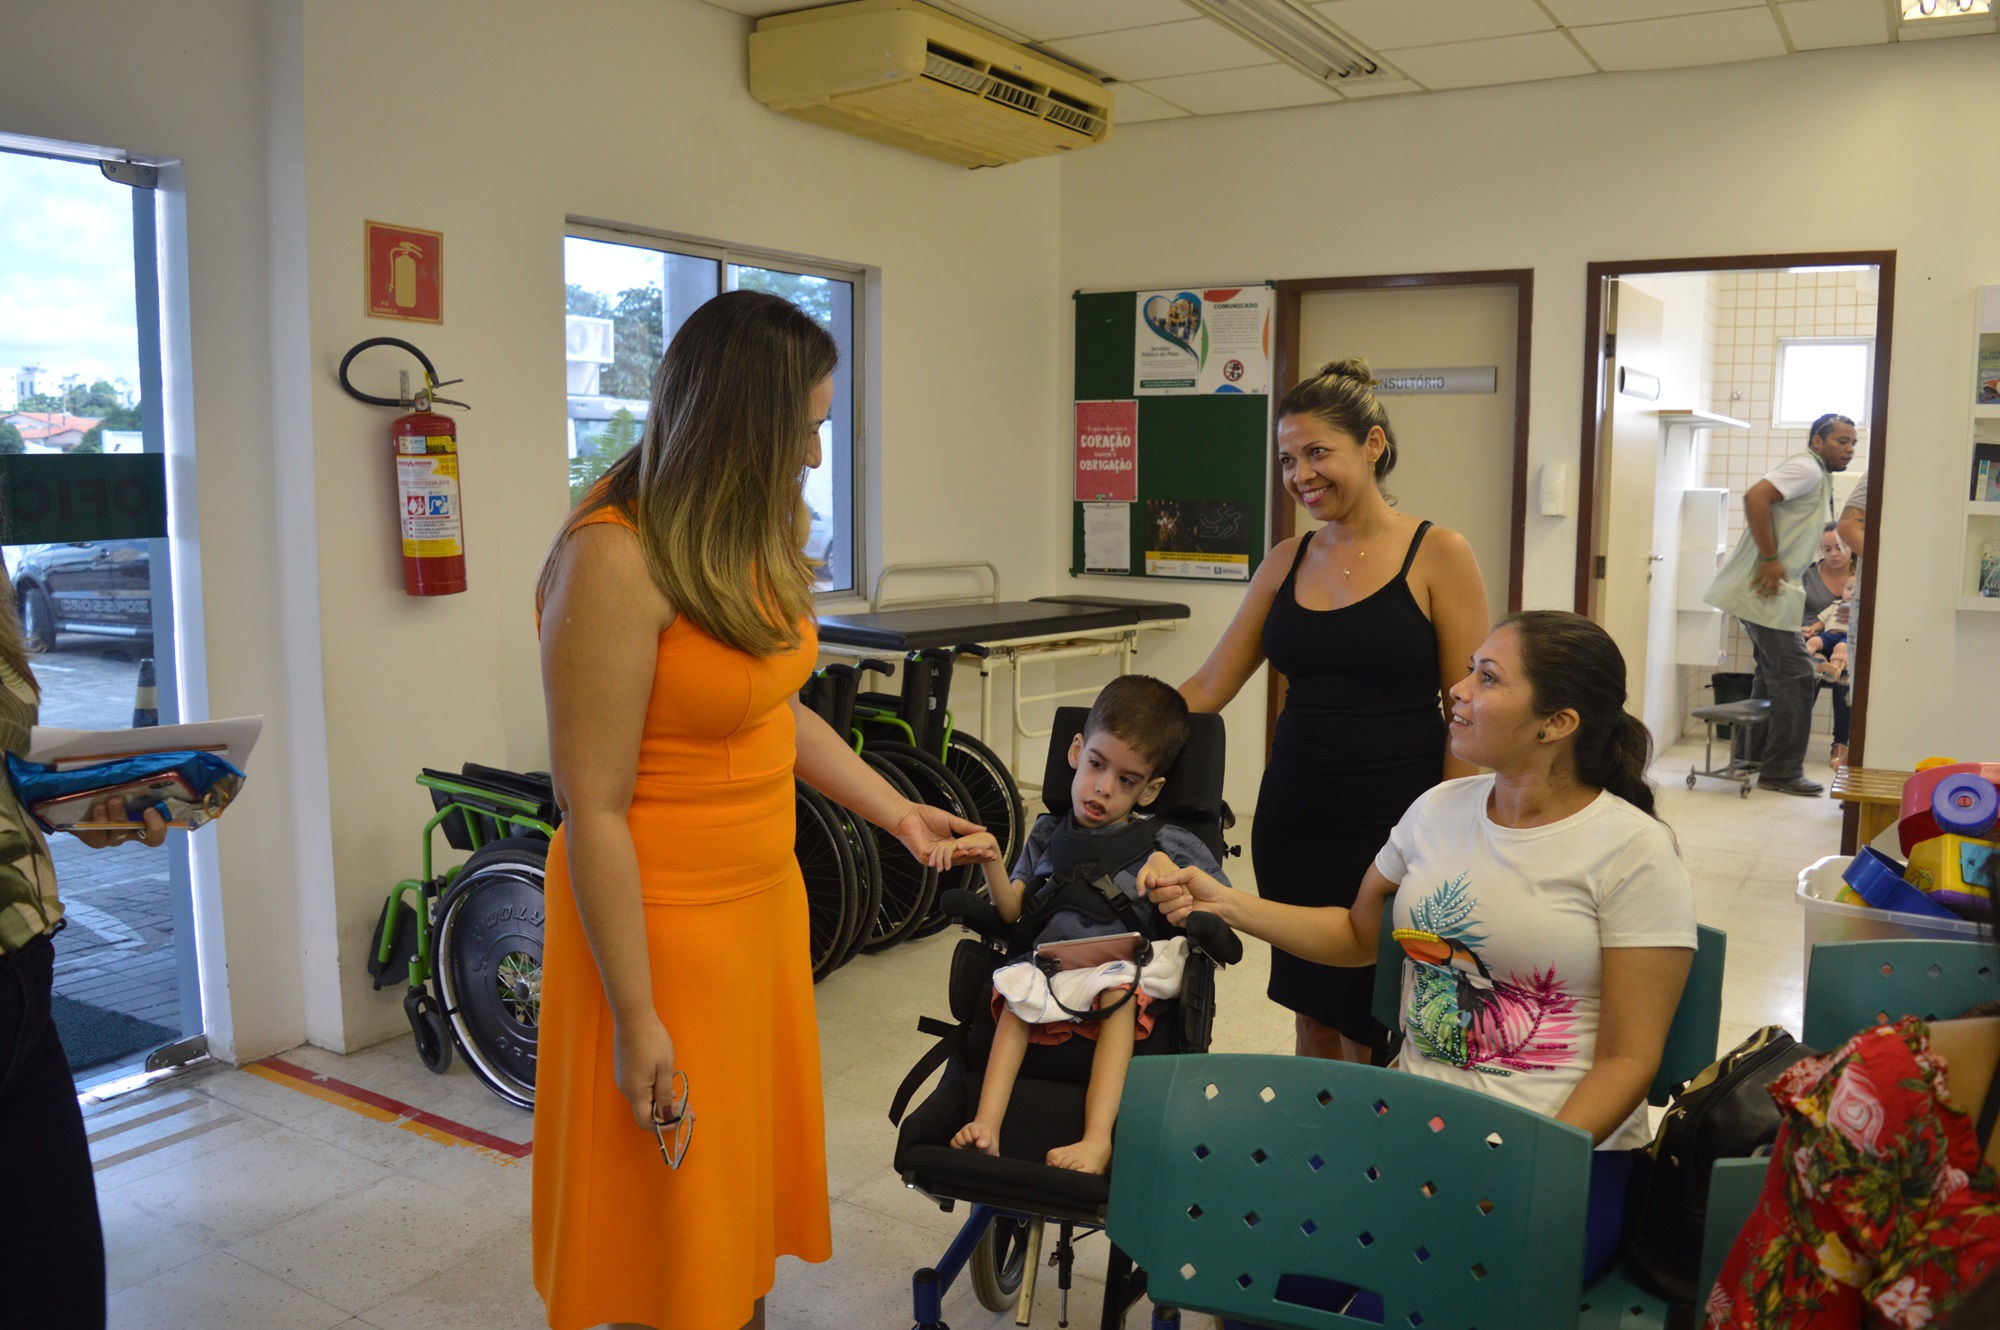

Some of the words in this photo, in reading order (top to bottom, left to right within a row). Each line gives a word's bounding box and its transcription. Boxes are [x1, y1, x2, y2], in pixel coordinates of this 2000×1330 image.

[1213, 302, 1259, 310] COMUNICADO
[1372, 374, 1445, 389] NSULTÓRIO
[1080, 432, 1131, 452] CORAÇÃO
[1079, 458, 1132, 474] OBRIGAÇÃO
[62, 599, 149, 613] CROSSFOX
